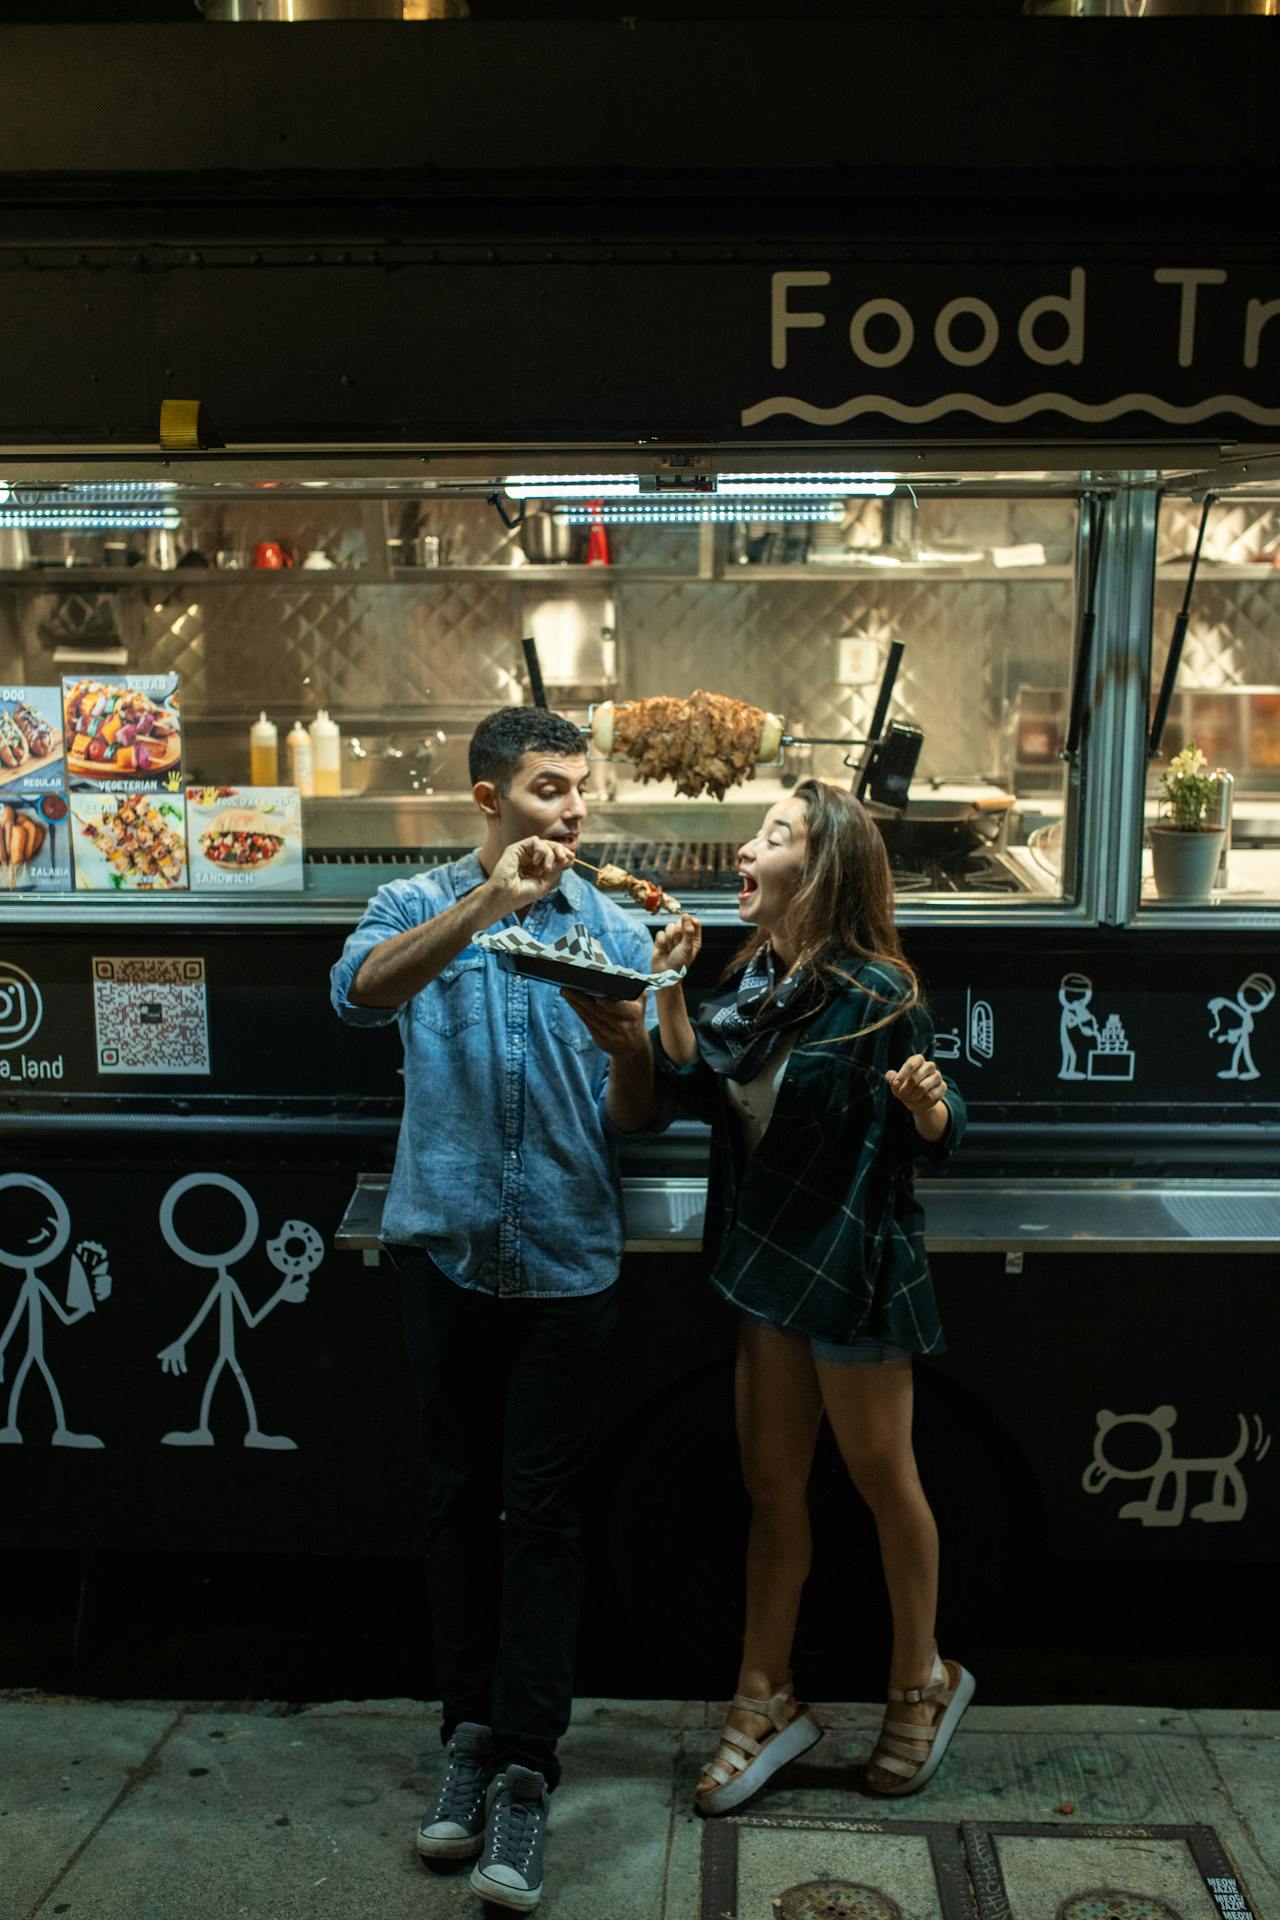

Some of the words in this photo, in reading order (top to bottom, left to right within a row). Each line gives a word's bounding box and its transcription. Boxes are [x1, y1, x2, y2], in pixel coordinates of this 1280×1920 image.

[771, 267, 1086, 369] Food
[1154, 267, 1280, 369] Tr
[128, 679, 166, 690] KEBAB
[3, 689, 25, 701] DOG
[23, 777, 62, 788] REGULAR
[99, 780, 157, 791] VEGETERIAN
[30, 866, 69, 877] ZALABIA
[194, 872, 254, 885] SANDWICH
[0, 1054, 63, 1080] a_land
[1207, 1878, 1236, 1886] MEOW
